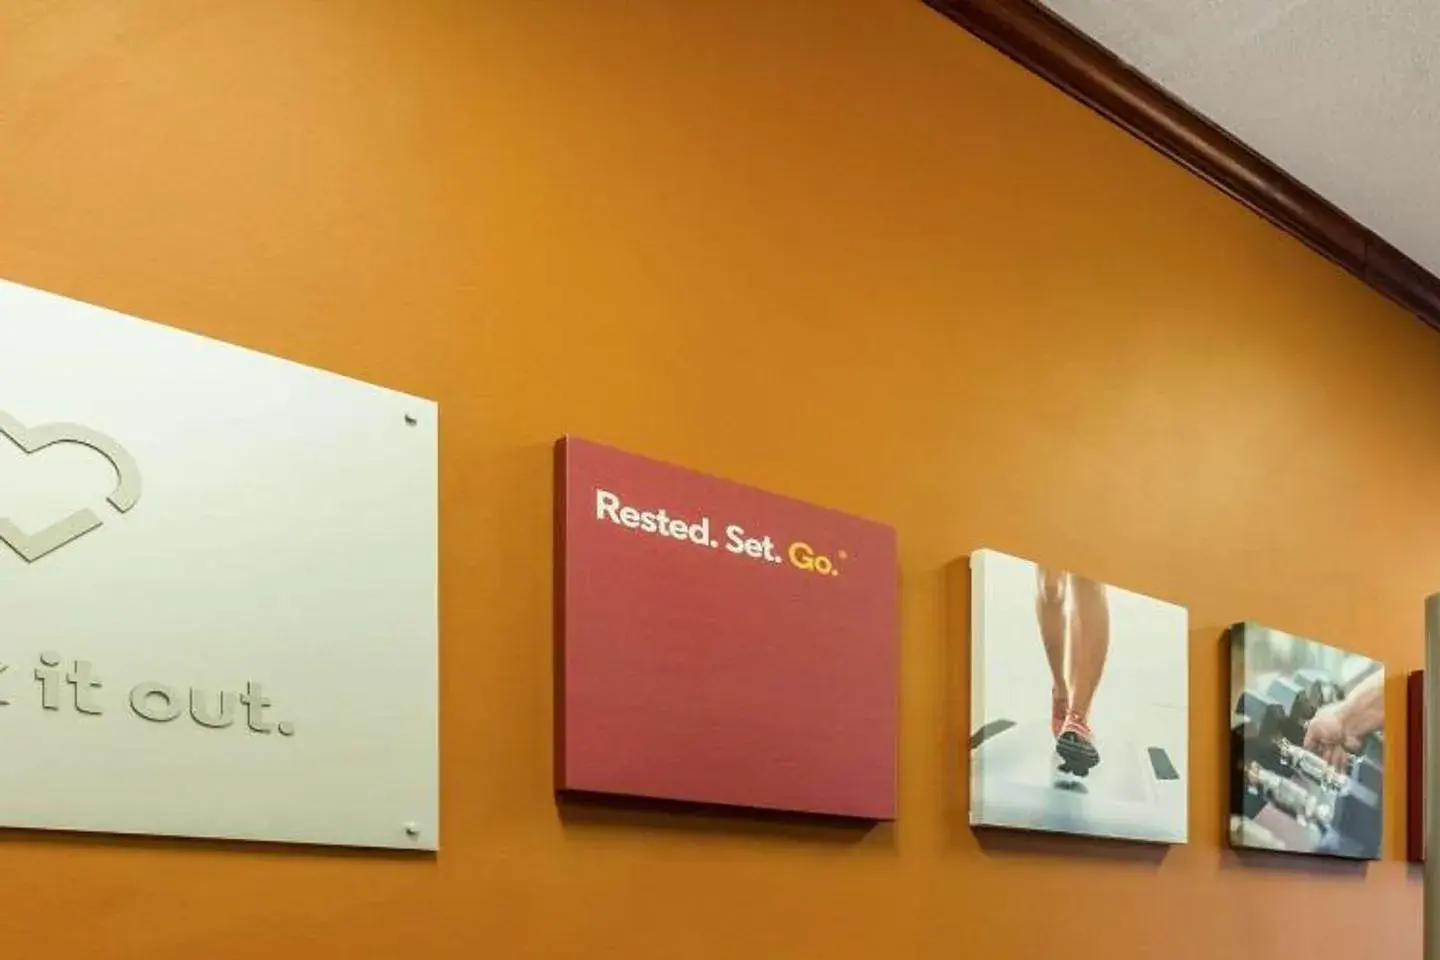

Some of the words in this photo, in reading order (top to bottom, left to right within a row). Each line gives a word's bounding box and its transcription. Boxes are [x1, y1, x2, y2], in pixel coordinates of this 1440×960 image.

[596, 488, 719, 549] Rested.
[725, 524, 782, 563] Set.
[34, 650, 103, 716] it
[128, 680, 294, 737] out.
